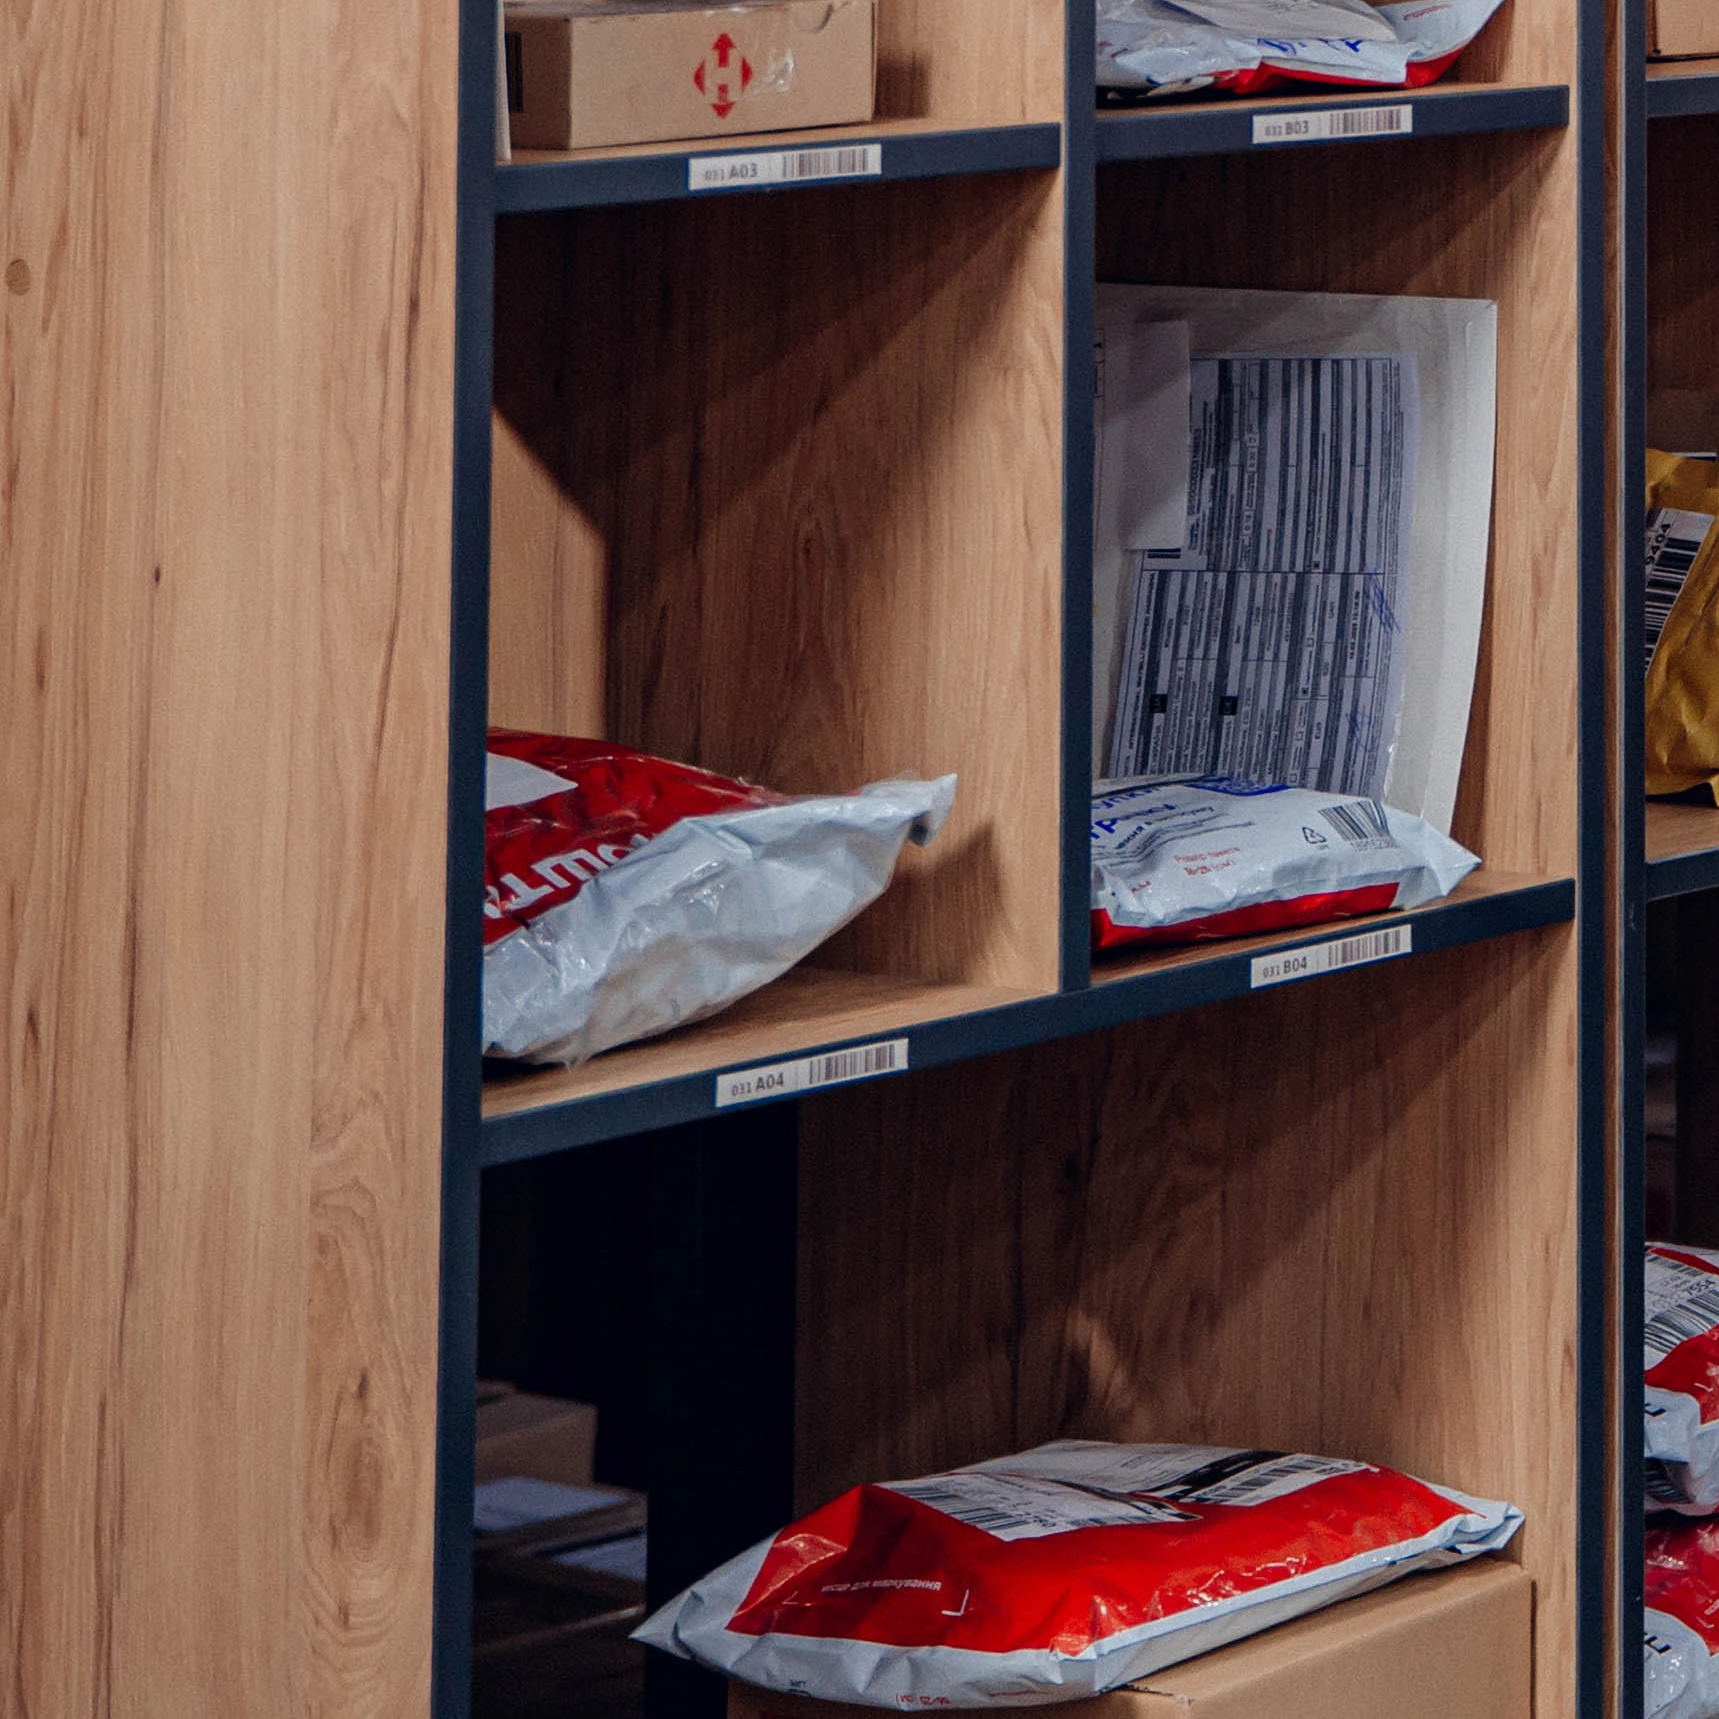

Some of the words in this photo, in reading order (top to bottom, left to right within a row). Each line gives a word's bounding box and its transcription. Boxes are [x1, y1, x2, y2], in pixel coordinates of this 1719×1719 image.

[1284, 120, 1310, 136] B03
[728, 161, 759, 180] A03
[1262, 963, 1282, 978] 031
[1283, 955, 1308, 975] B04
[730, 1081, 752, 1097] 031
[755, 1071, 785, 1093] A04
